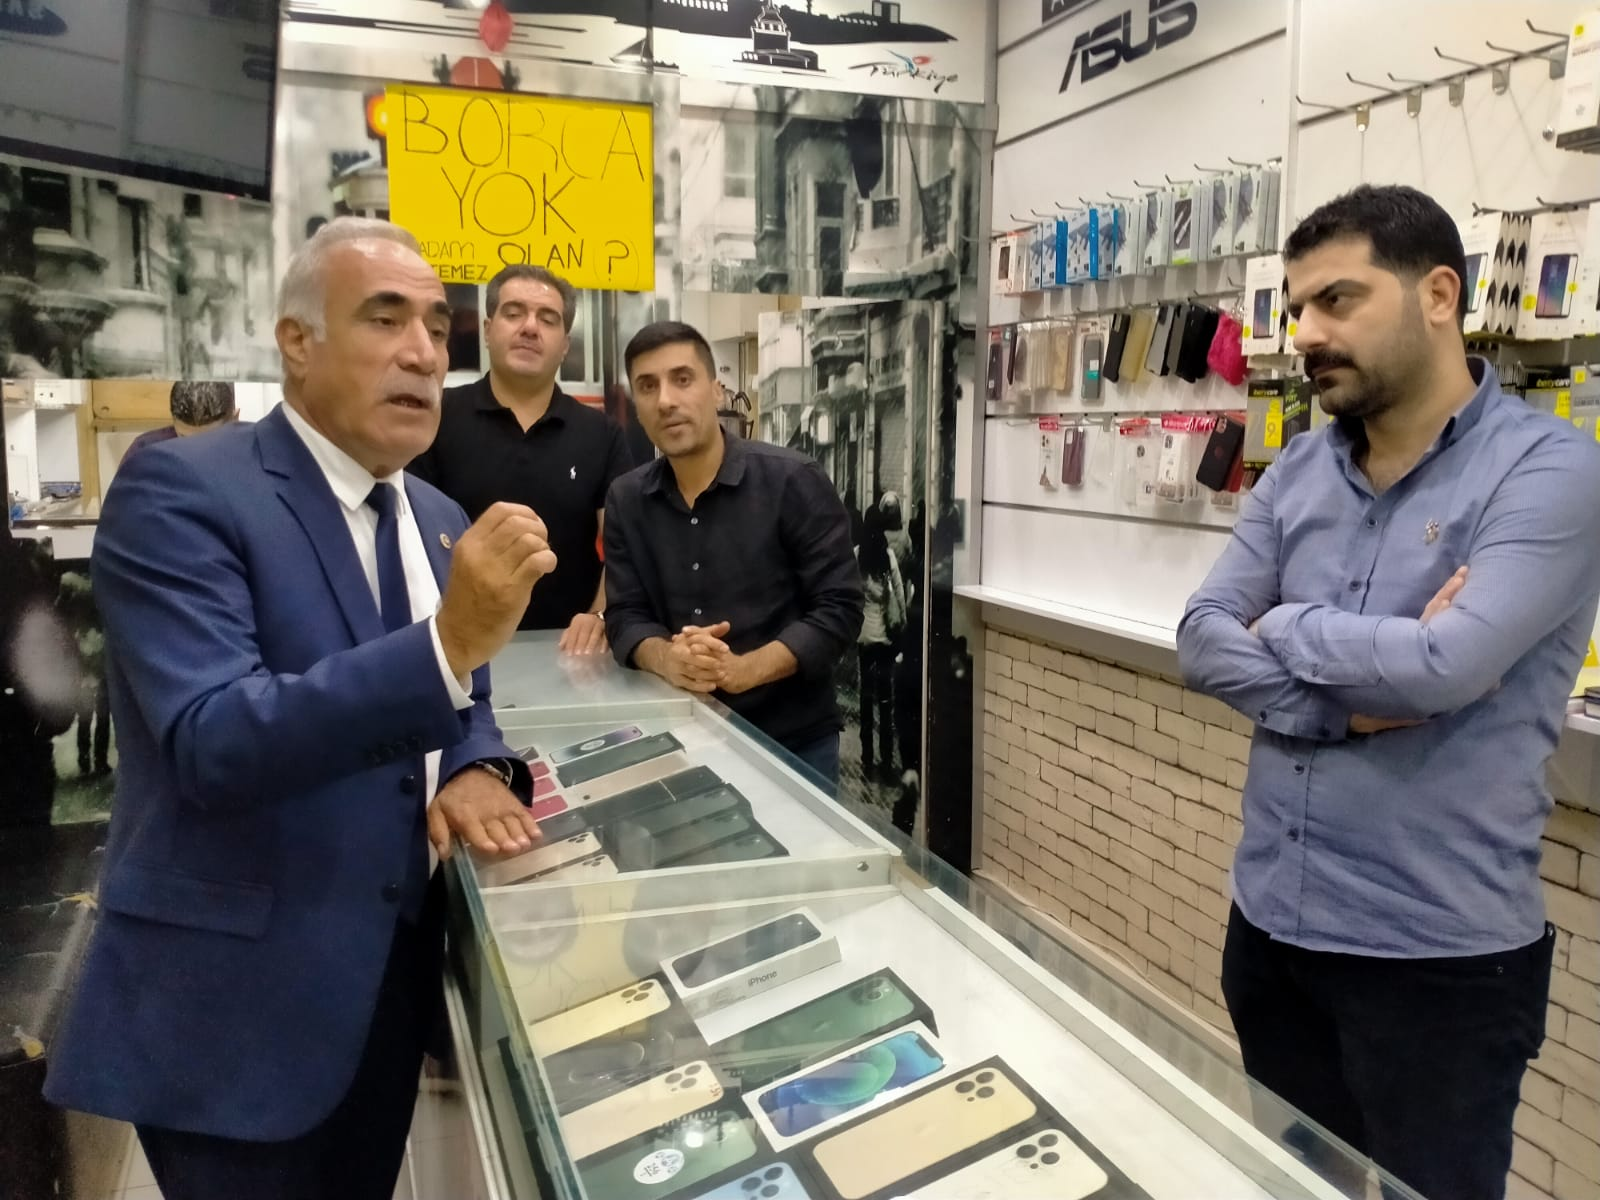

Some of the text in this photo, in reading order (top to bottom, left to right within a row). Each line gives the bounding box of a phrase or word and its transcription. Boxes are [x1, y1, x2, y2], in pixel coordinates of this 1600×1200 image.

[1058, 0, 1198, 94] ASUS
[402, 89, 645, 183] BORCA
[440, 166, 577, 237] YOK
[748, 970, 778, 987] iPhone
